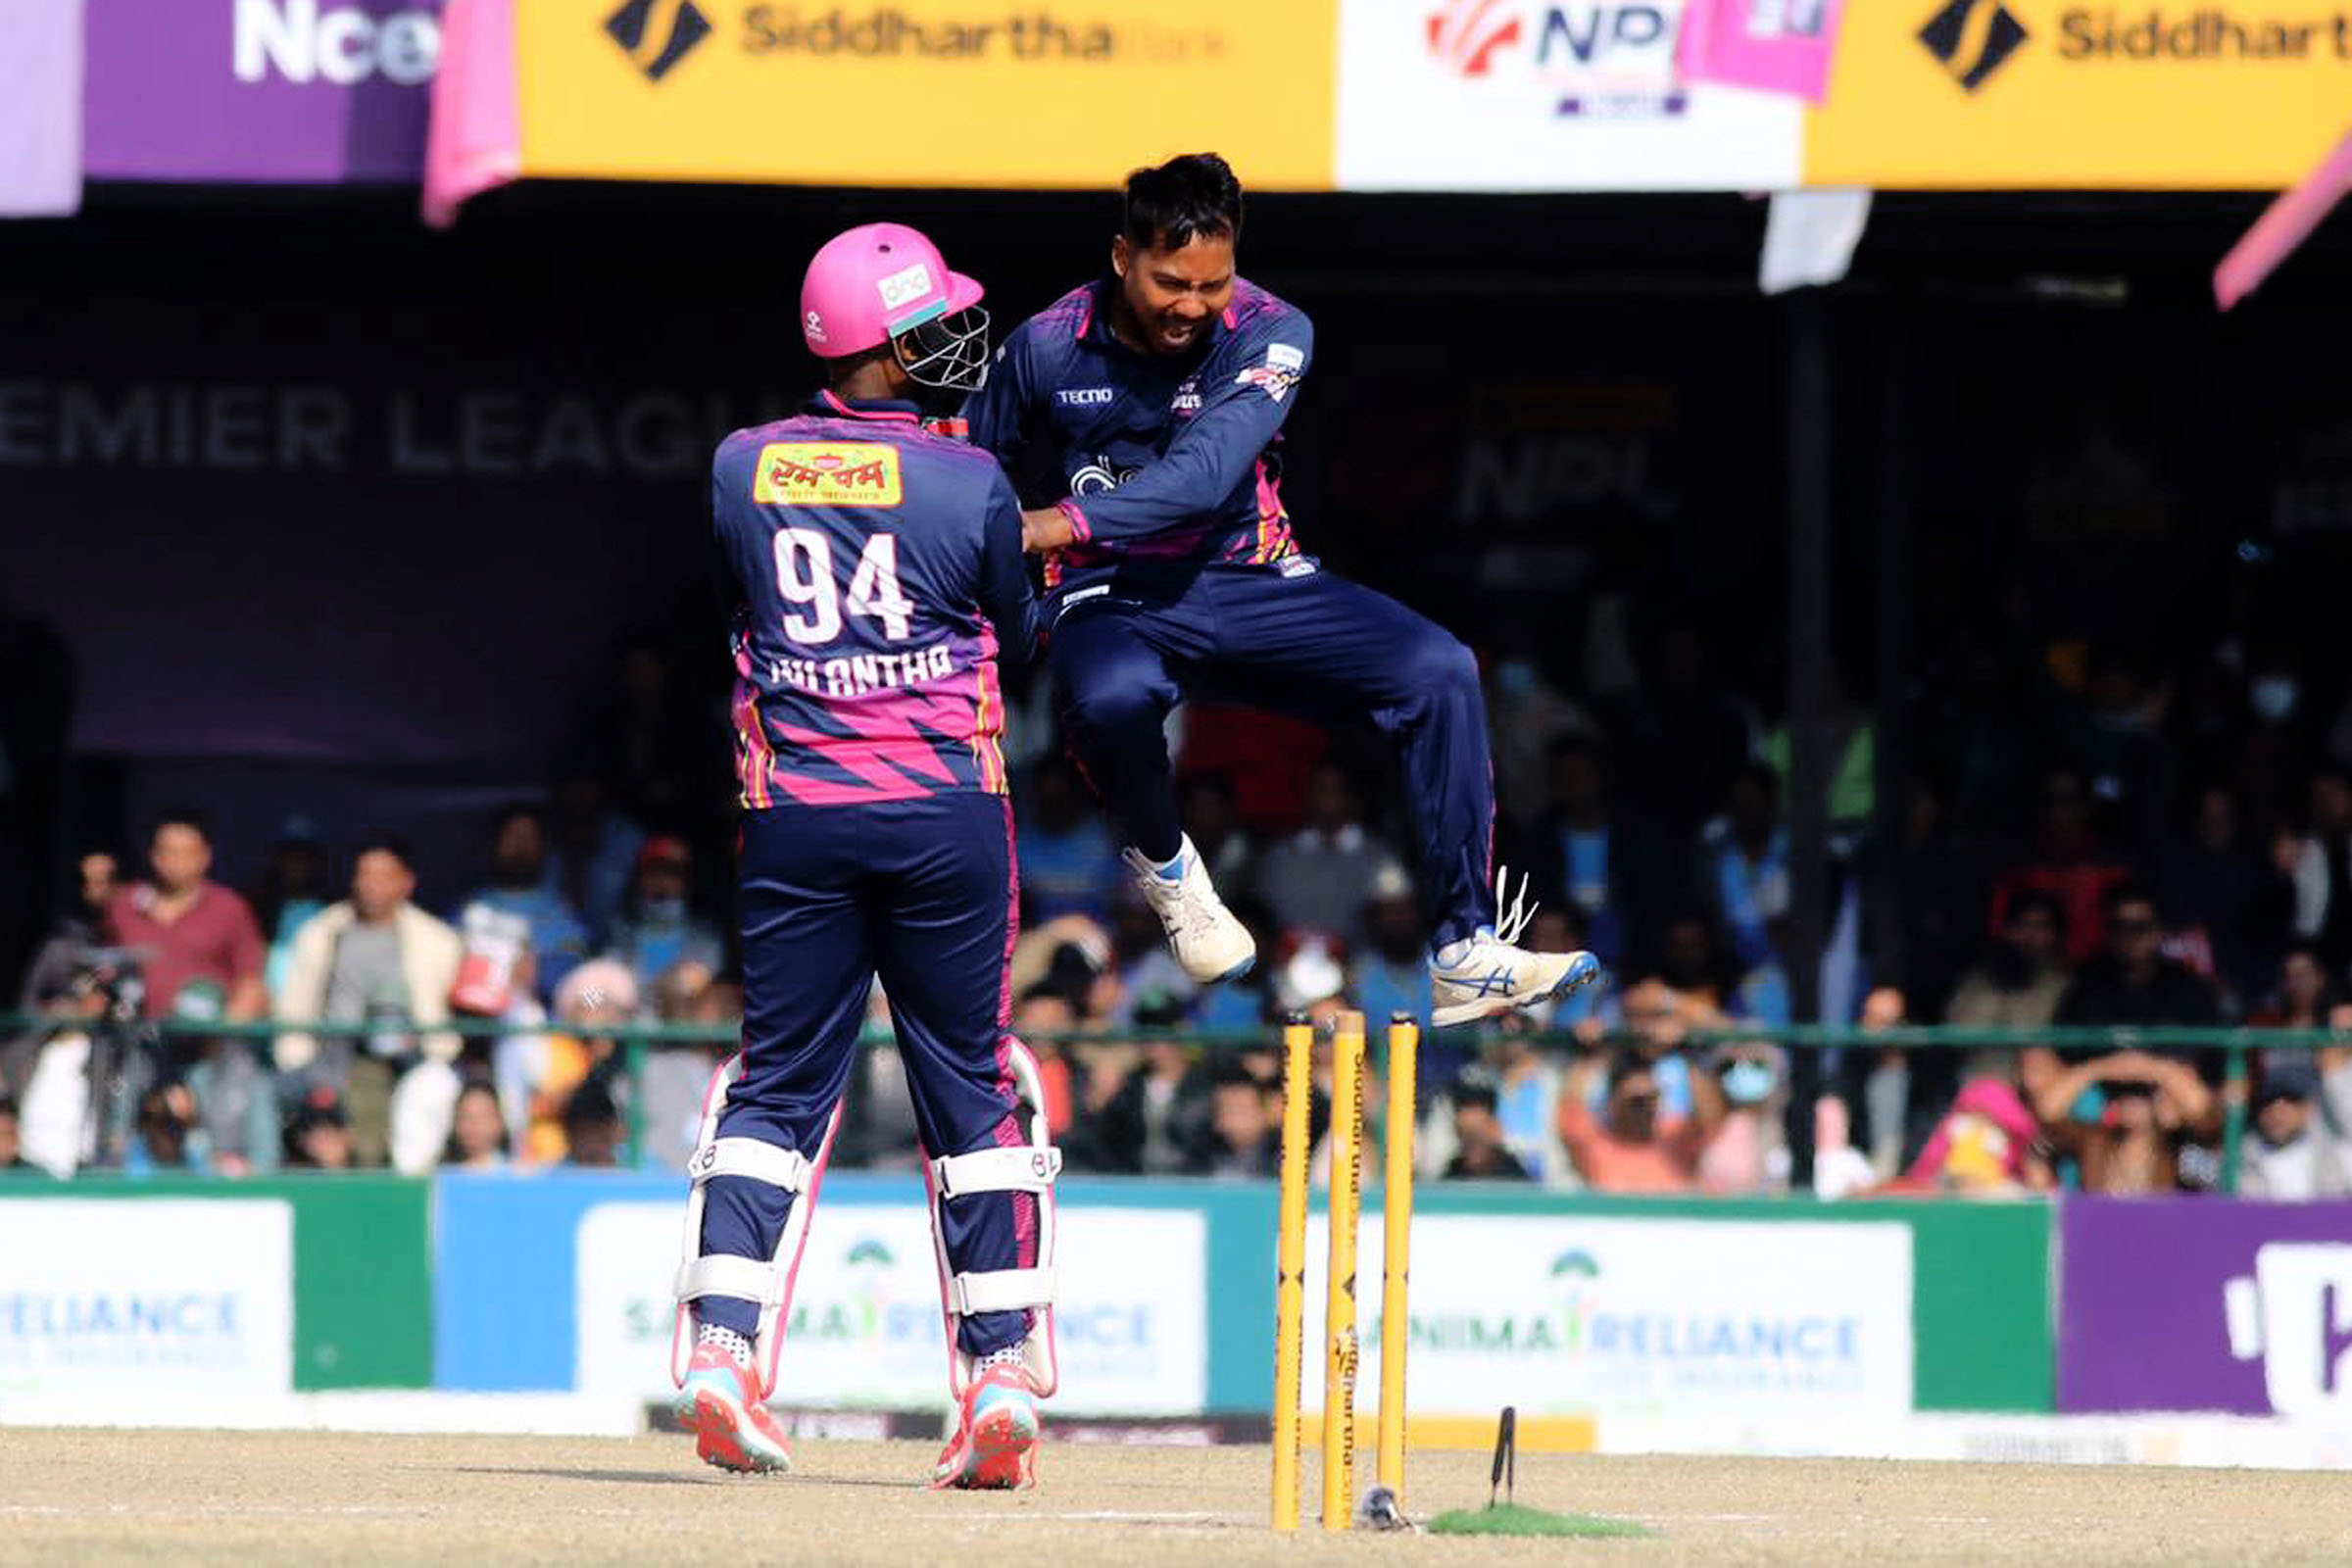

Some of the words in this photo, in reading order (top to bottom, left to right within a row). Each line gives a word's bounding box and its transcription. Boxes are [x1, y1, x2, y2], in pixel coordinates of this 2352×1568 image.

[233, 0, 439, 82] Nce
[741, 8, 1115, 61] Siddhartha
[1536, 7, 1674, 66] NP
[1057, 387, 1114, 405] TECNO
[773, 527, 914, 643] 94
[0, 1292, 239, 1337] ELIANCE
[1591, 1313, 1860, 1358] RELIANCE
